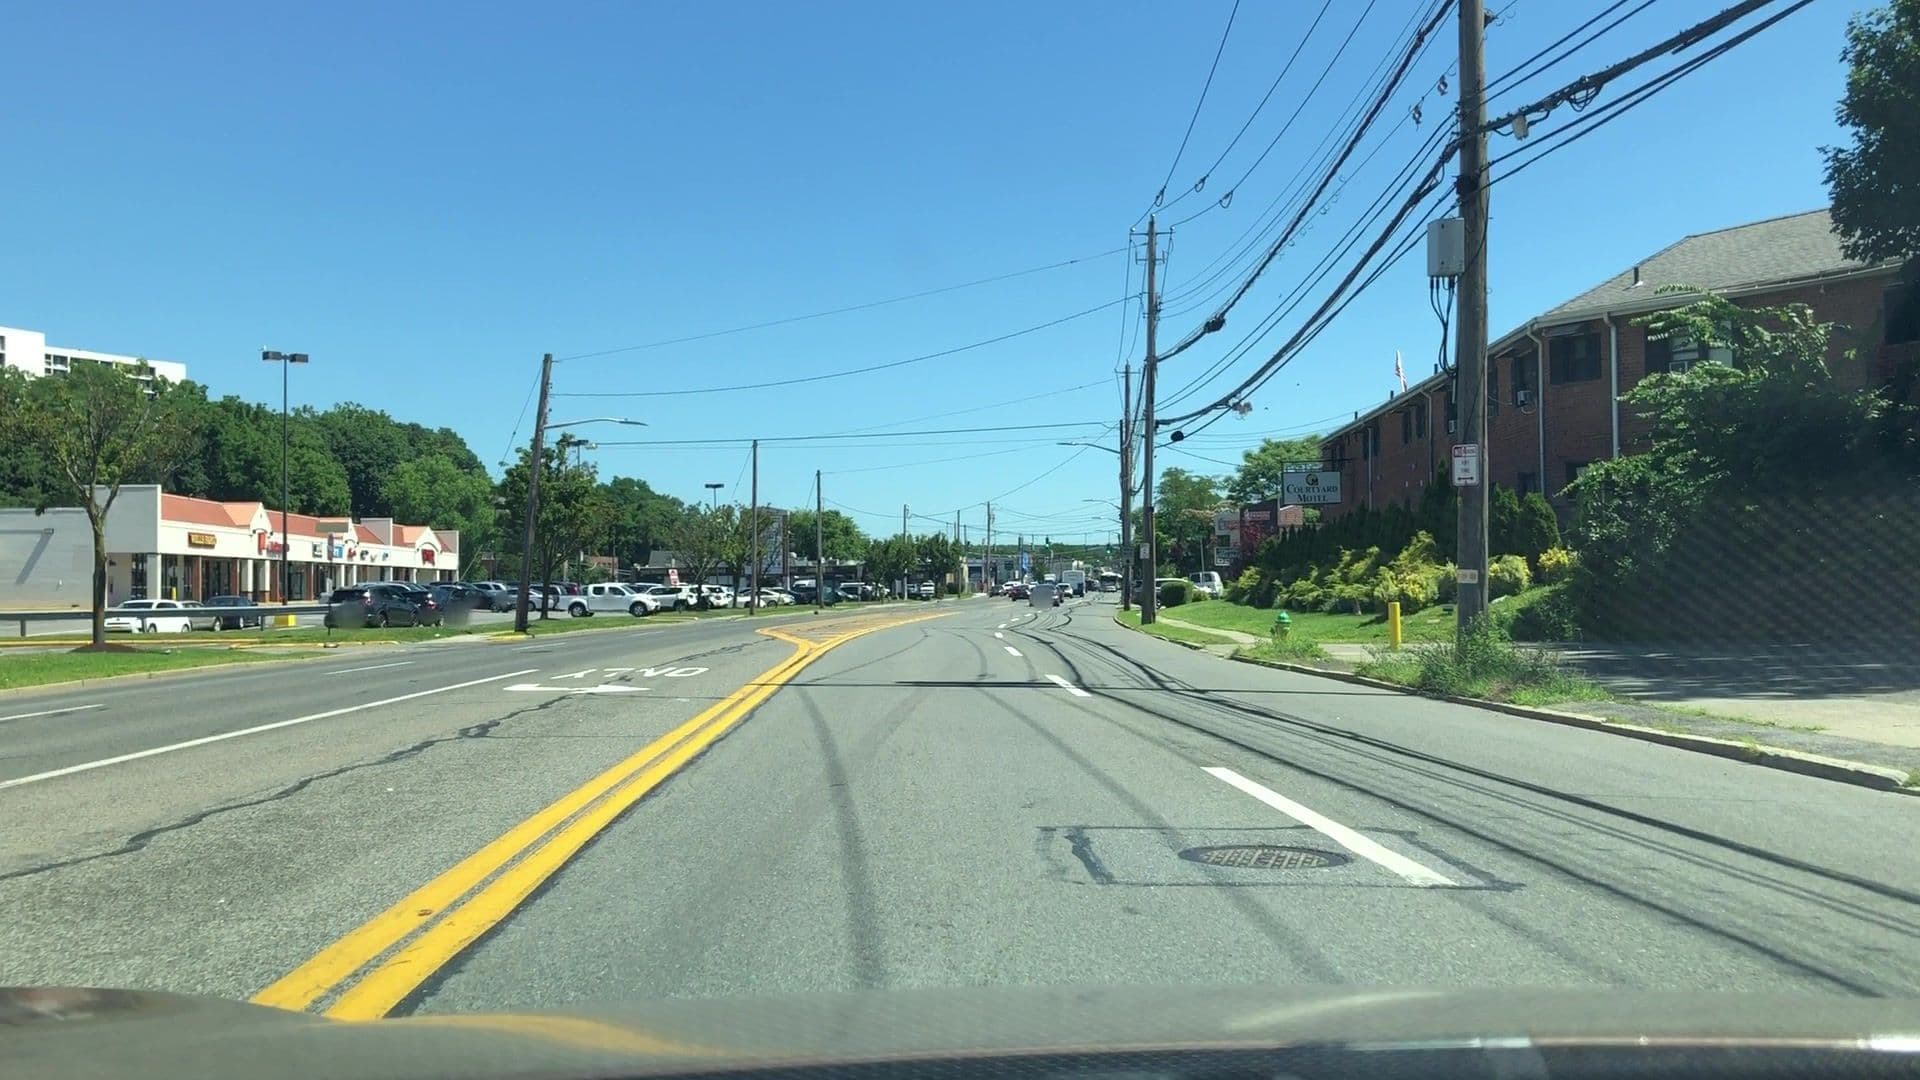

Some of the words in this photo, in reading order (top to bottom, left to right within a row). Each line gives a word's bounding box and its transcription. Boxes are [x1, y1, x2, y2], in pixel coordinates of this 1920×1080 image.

[1286, 483, 1338, 494] COURTYARD
[1297, 494, 1328, 503] MOTEL
[551, 667, 709, 679] ONLY
